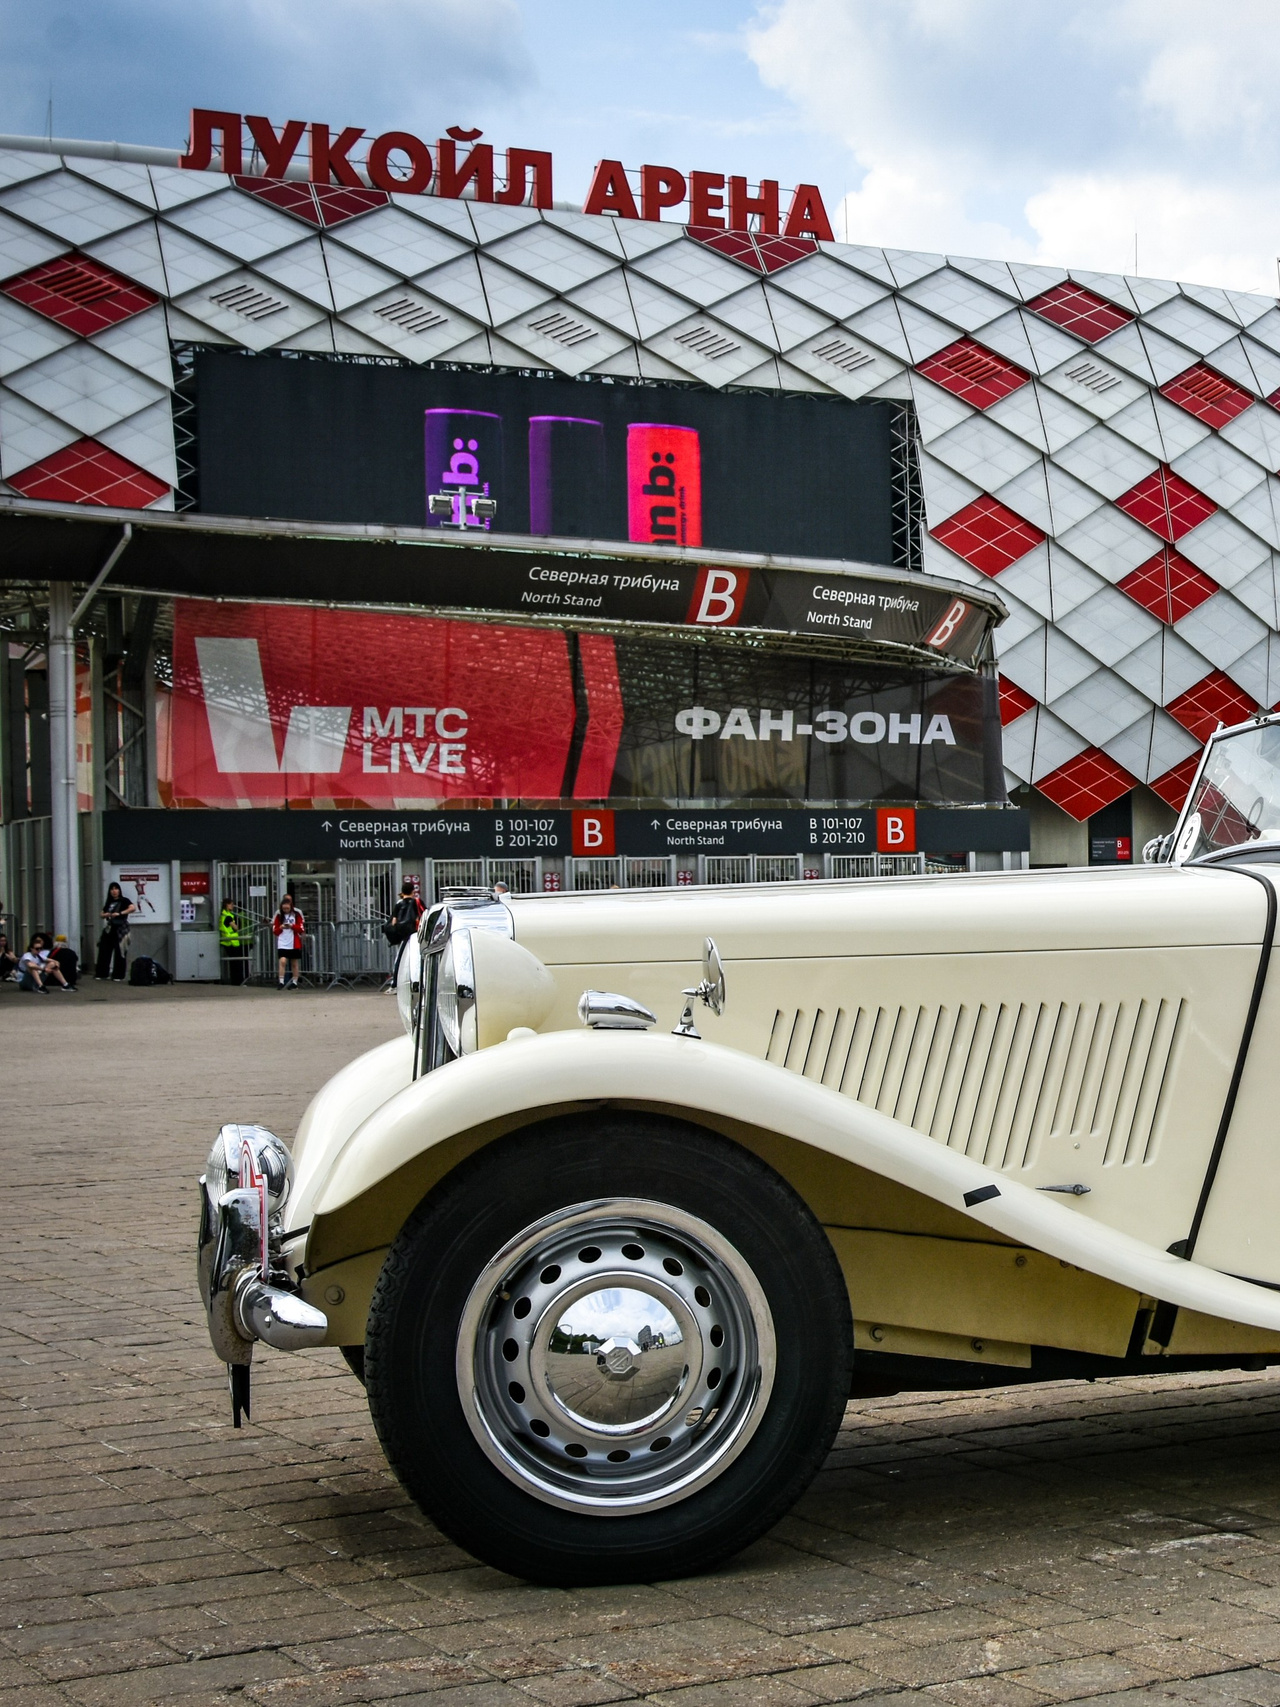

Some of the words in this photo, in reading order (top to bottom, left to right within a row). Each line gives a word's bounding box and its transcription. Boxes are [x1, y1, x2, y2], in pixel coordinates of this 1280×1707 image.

[178, 108, 554, 210] ЛУКОЙЛ
[581, 158, 836, 242] АРЕНА
[528, 566, 609, 586] Северная
[613, 574, 680, 593] трибуна
[521, 591, 561, 605] North
[562, 593, 602, 608] Stand
[812, 585, 876, 606] Северная
[878, 595, 920, 613] трибуна
[806, 610, 841, 626] North
[842, 614, 873, 630] Stand
[674, 706, 957, 746] ФАН-ЗОНА
[362, 742, 467, 774] LIVE
[339, 820, 408, 834] Северная
[411, 819, 471, 835] трибуна
[509, 819, 555, 832] 101-107
[666, 818, 728, 832] Северная
[730, 817, 783, 833] трибуна
[822, 817, 863, 830] 101-107
[340, 838, 371, 848] North
[374, 837, 405, 848] Stand
[509, 835, 558, 848] 201-210
[667, 836, 695, 846] North
[697, 835, 725, 846] Stand
[822, 832, 866, 844] 201-210
